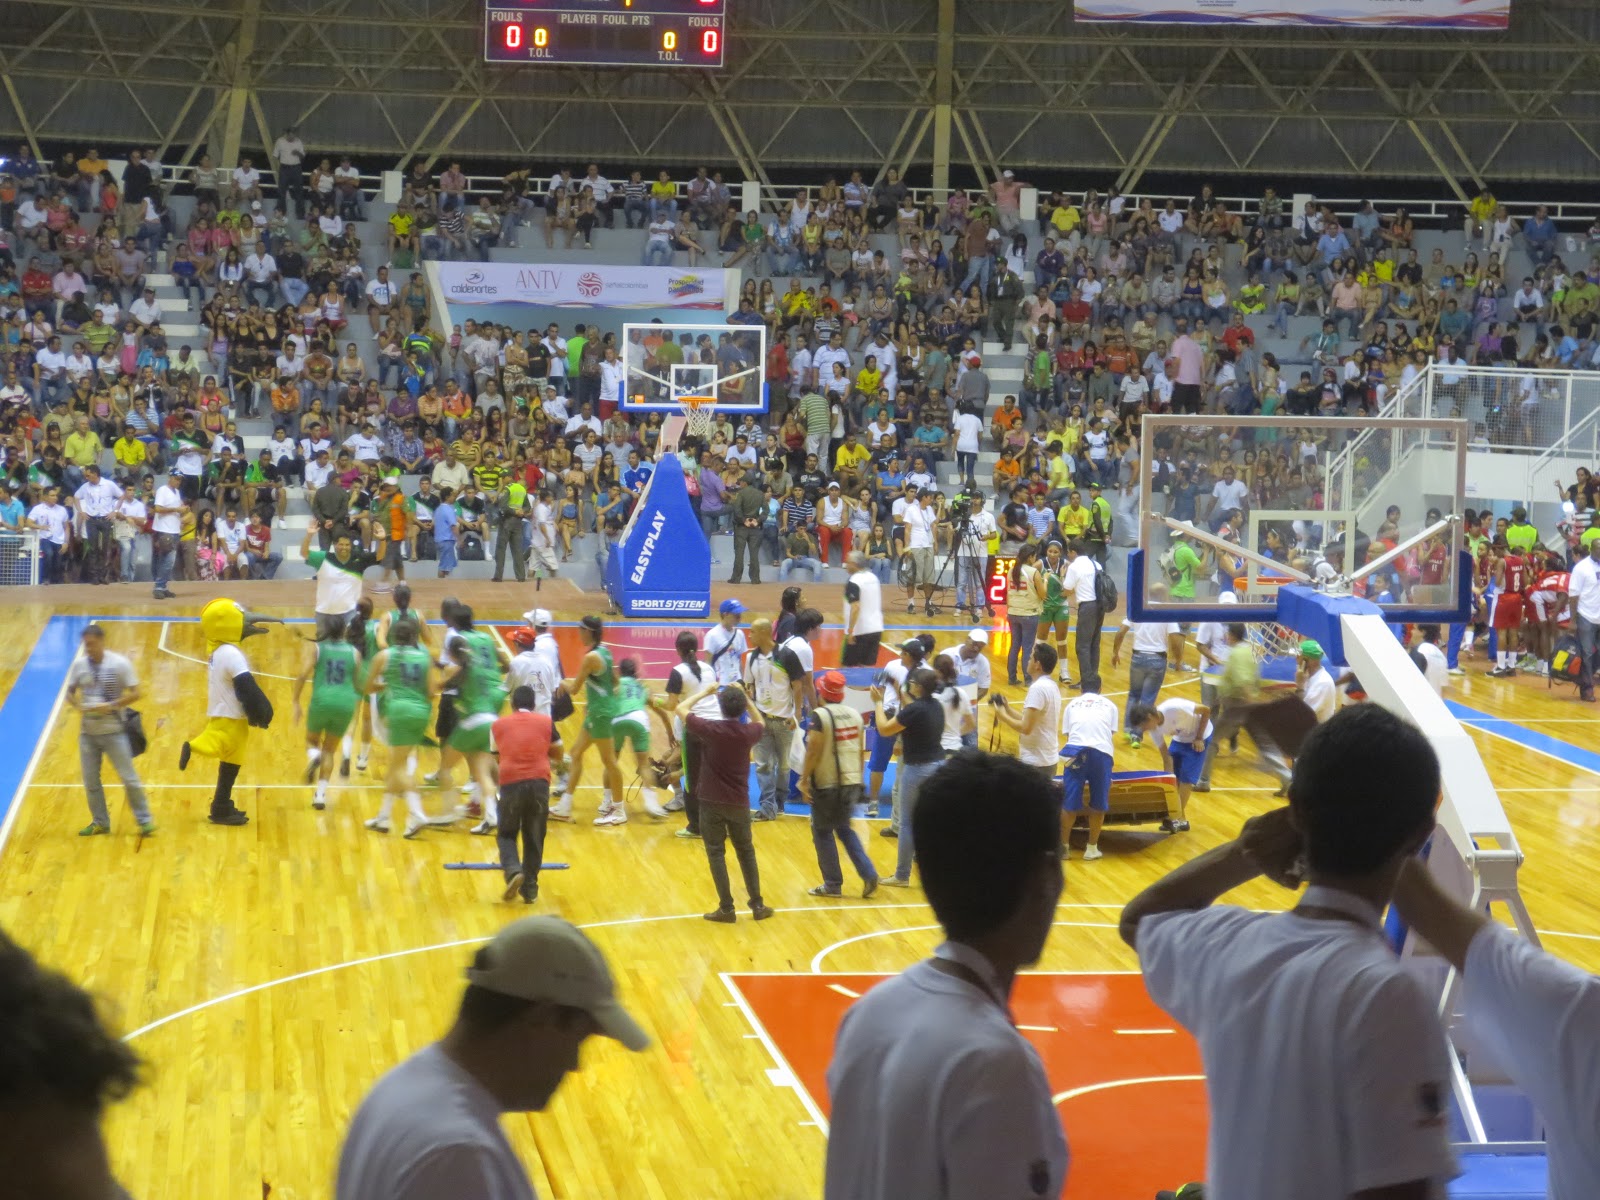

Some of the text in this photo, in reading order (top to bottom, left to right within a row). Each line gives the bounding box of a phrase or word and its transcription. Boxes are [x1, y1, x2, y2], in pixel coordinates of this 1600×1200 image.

[491, 11, 523, 22] FOULS
[561, 14, 650, 25] PLAYER FOUL PTS
[688, 16, 720, 27] FOULS
[506, 25, 520, 47] 0
[534, 28, 547, 46] 0
[663, 31, 676, 49] 0
[703, 30, 718, 52] 0
[528, 48, 554, 58] T.O.L.
[658, 51, 683, 61] T.O.L.
[515, 269, 563, 290] ANTV
[451, 283, 498, 295] coldeportes
[630, 509, 667, 585] EASYPLAY
[631, 599, 707, 610] SPORTSYSTEM
